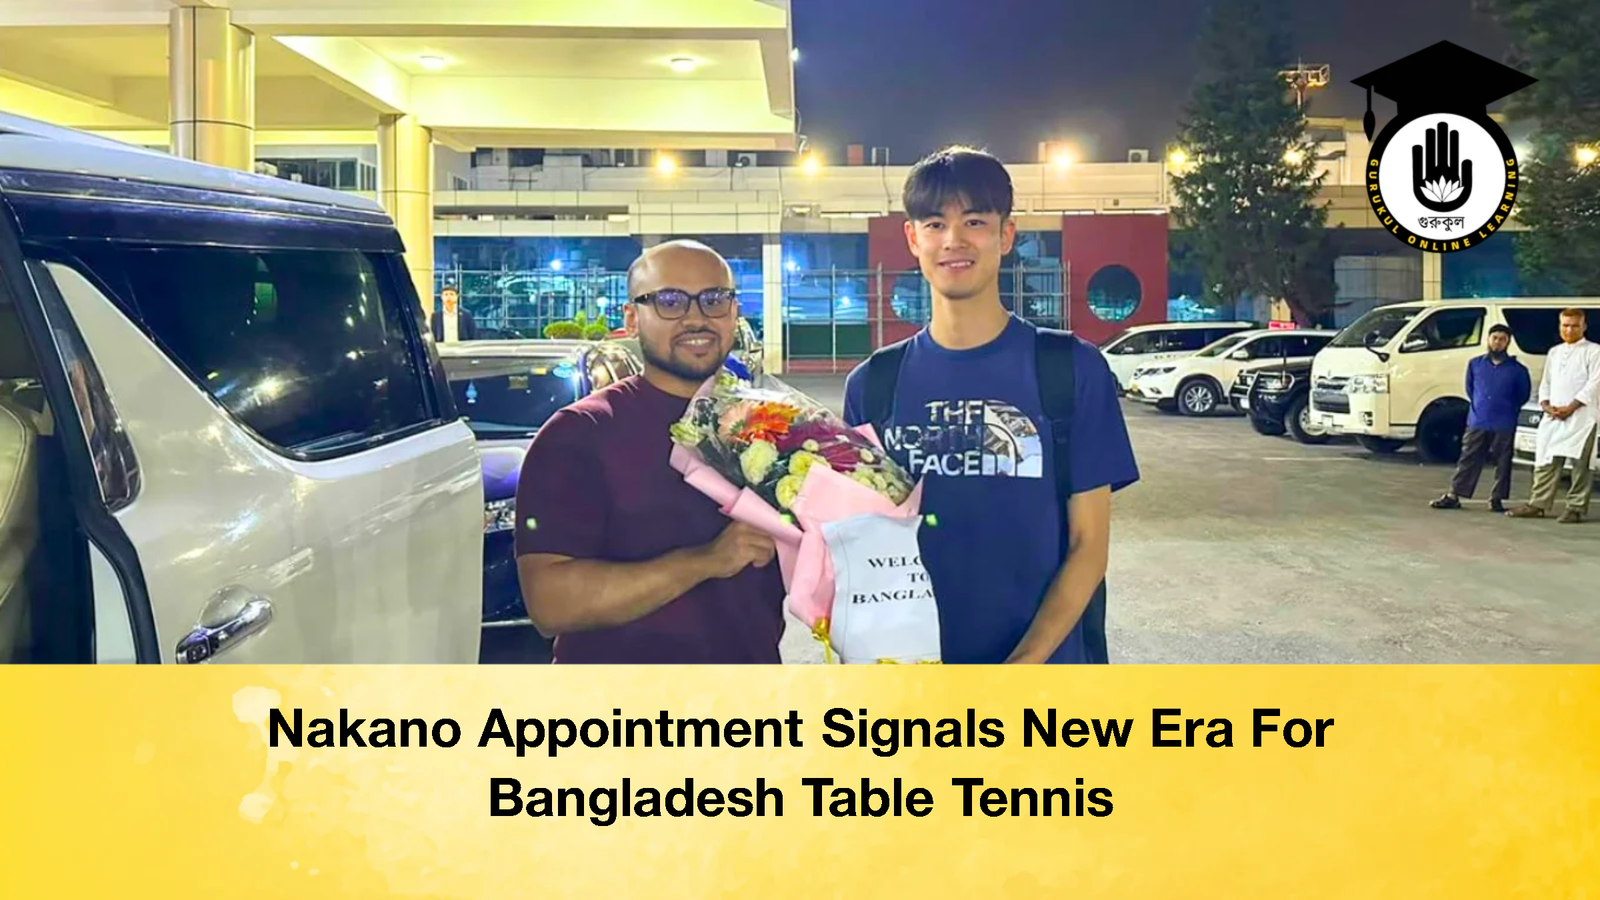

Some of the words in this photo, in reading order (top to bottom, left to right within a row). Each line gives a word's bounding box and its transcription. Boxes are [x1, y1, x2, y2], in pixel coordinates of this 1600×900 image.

[925, 399, 983, 424] THE
[908, 449, 981, 476] FACE
[907, 572, 930, 583] TO
